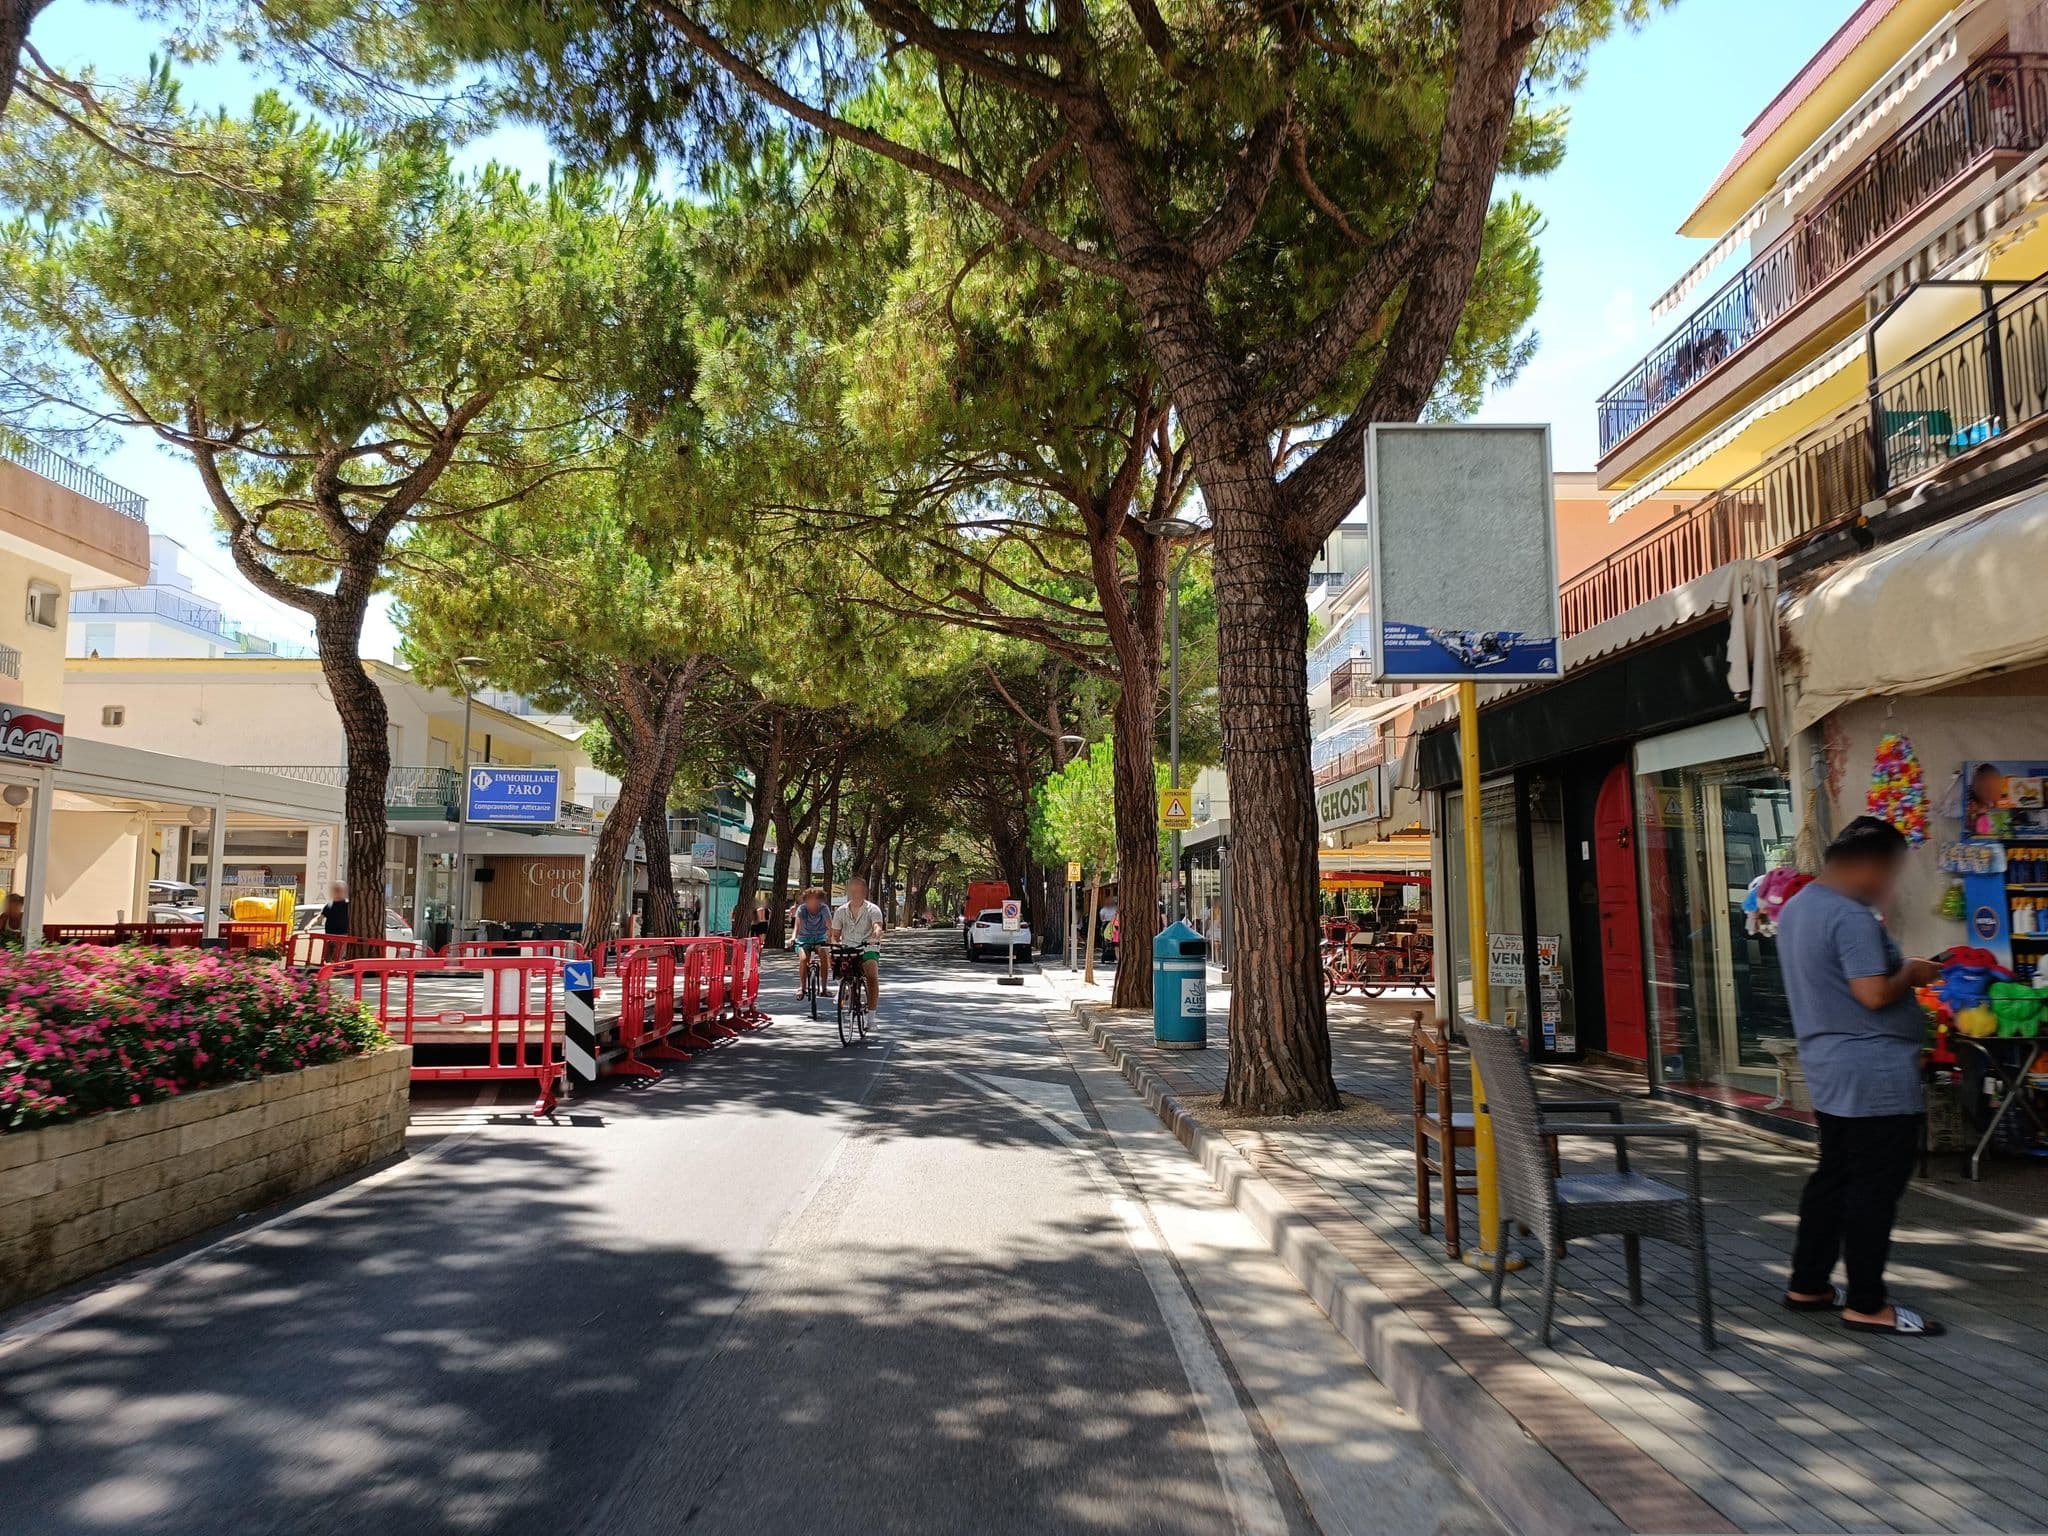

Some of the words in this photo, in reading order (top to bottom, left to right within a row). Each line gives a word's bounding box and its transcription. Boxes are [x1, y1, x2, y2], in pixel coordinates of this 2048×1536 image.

[495, 774, 556, 783] IMMOBILIARE
[507, 784, 542, 796] FARO
[474, 803, 520, 811] Compravendite
[1320, 780, 1369, 823] GHOST
[163, 828, 176, 882] FLATS
[523, 863, 582, 886] Creme
[1492, 952, 1556, 966] VENSI
